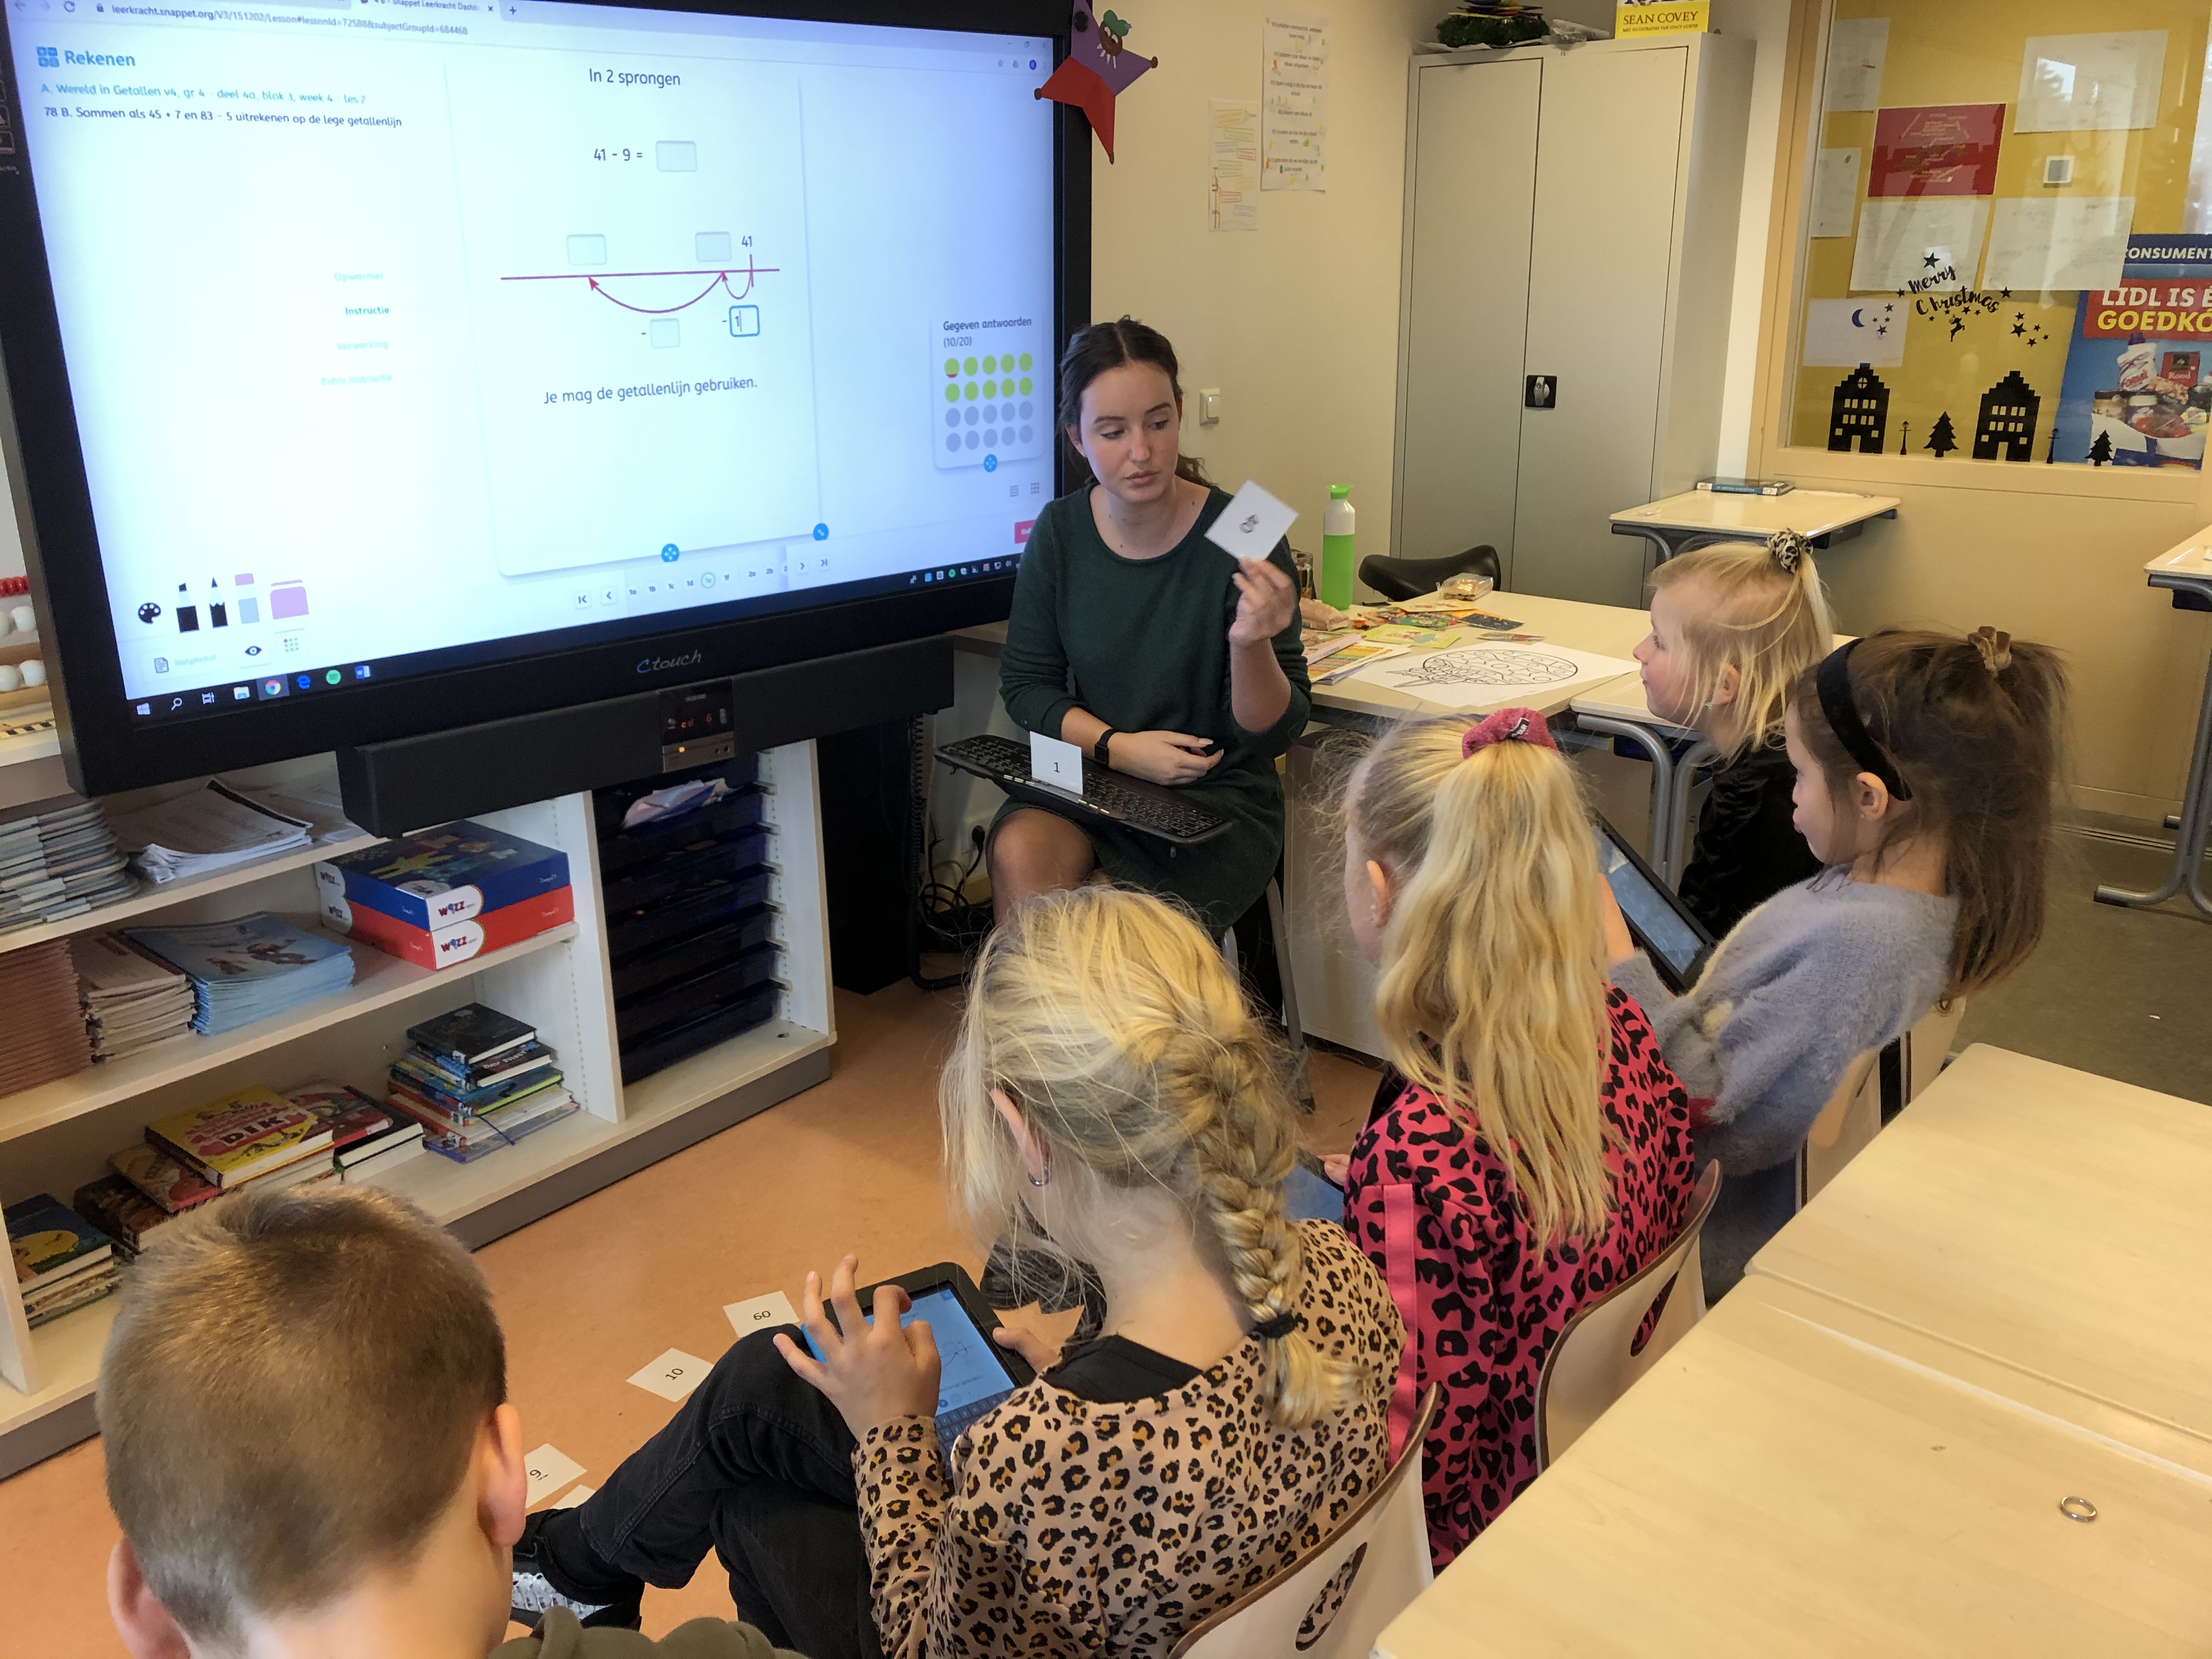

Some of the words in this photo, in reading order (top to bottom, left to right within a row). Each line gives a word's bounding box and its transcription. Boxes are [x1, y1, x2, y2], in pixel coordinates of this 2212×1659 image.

[1623, 14, 1655, 25] SEAN
[1657, 11, 1698, 23] COVEY
[64, 50, 136, 66] Rekenen
[589, 68, 602, 83] In
[607, 69, 614, 83] 2
[618, 72, 681, 89] sprongen
[56, 84, 97, 95] Wereld
[100, 84, 110, 95] in
[114, 84, 161, 96] Getallen
[183, 89, 194, 99] gr
[217, 89, 239, 99] deel
[262, 91, 284, 100] blok
[299, 93, 324, 102] week
[345, 94, 358, 104] les
[44, 106, 58, 117] 78
[76, 106, 125, 119] Sommen
[129, 109, 146, 119] als
[149, 109, 161, 119] 45
[175, 110, 180, 120] 7
[184, 111, 198, 120] en
[200, 111, 213, 120] 83
[226, 112, 232, 121] 5
[236, 112, 290, 123] uitrekenen
[293, 115, 305, 125] op
[309, 115, 320, 124] de
[324, 116, 345, 126] lege
[348, 116, 402, 128] getallenlijn
[593, 148, 606, 161] 41
[622, 148, 631, 161] 9
[741, 235, 753, 247] 41
[2124, 247, 2212, 259] ONSUMEN
[1916, 285, 2000, 315] Christmas
[2102, 287, 2161, 307] LIDL
[2166, 288, 2195, 307] IS
[345, 306, 390, 314] Instructie
[943, 320, 979, 332] Gegeven
[981, 317, 1032, 329] antwoorden
[943, 336, 972, 348] (10/20)
[544, 391, 557, 404] Je
[562, 388, 592, 404] mag
[597, 386, 613, 400] de
[618, 381, 690, 402] getallenlijn
[695, 376, 758, 396] gebruiken.
[636, 650, 702, 674] Ctouch
[1053, 761, 1060, 774] 1
[221, 1115, 280, 1146] DIK
[752, 1310, 771, 1321] 60
[665, 1368, 684, 1381] 10
